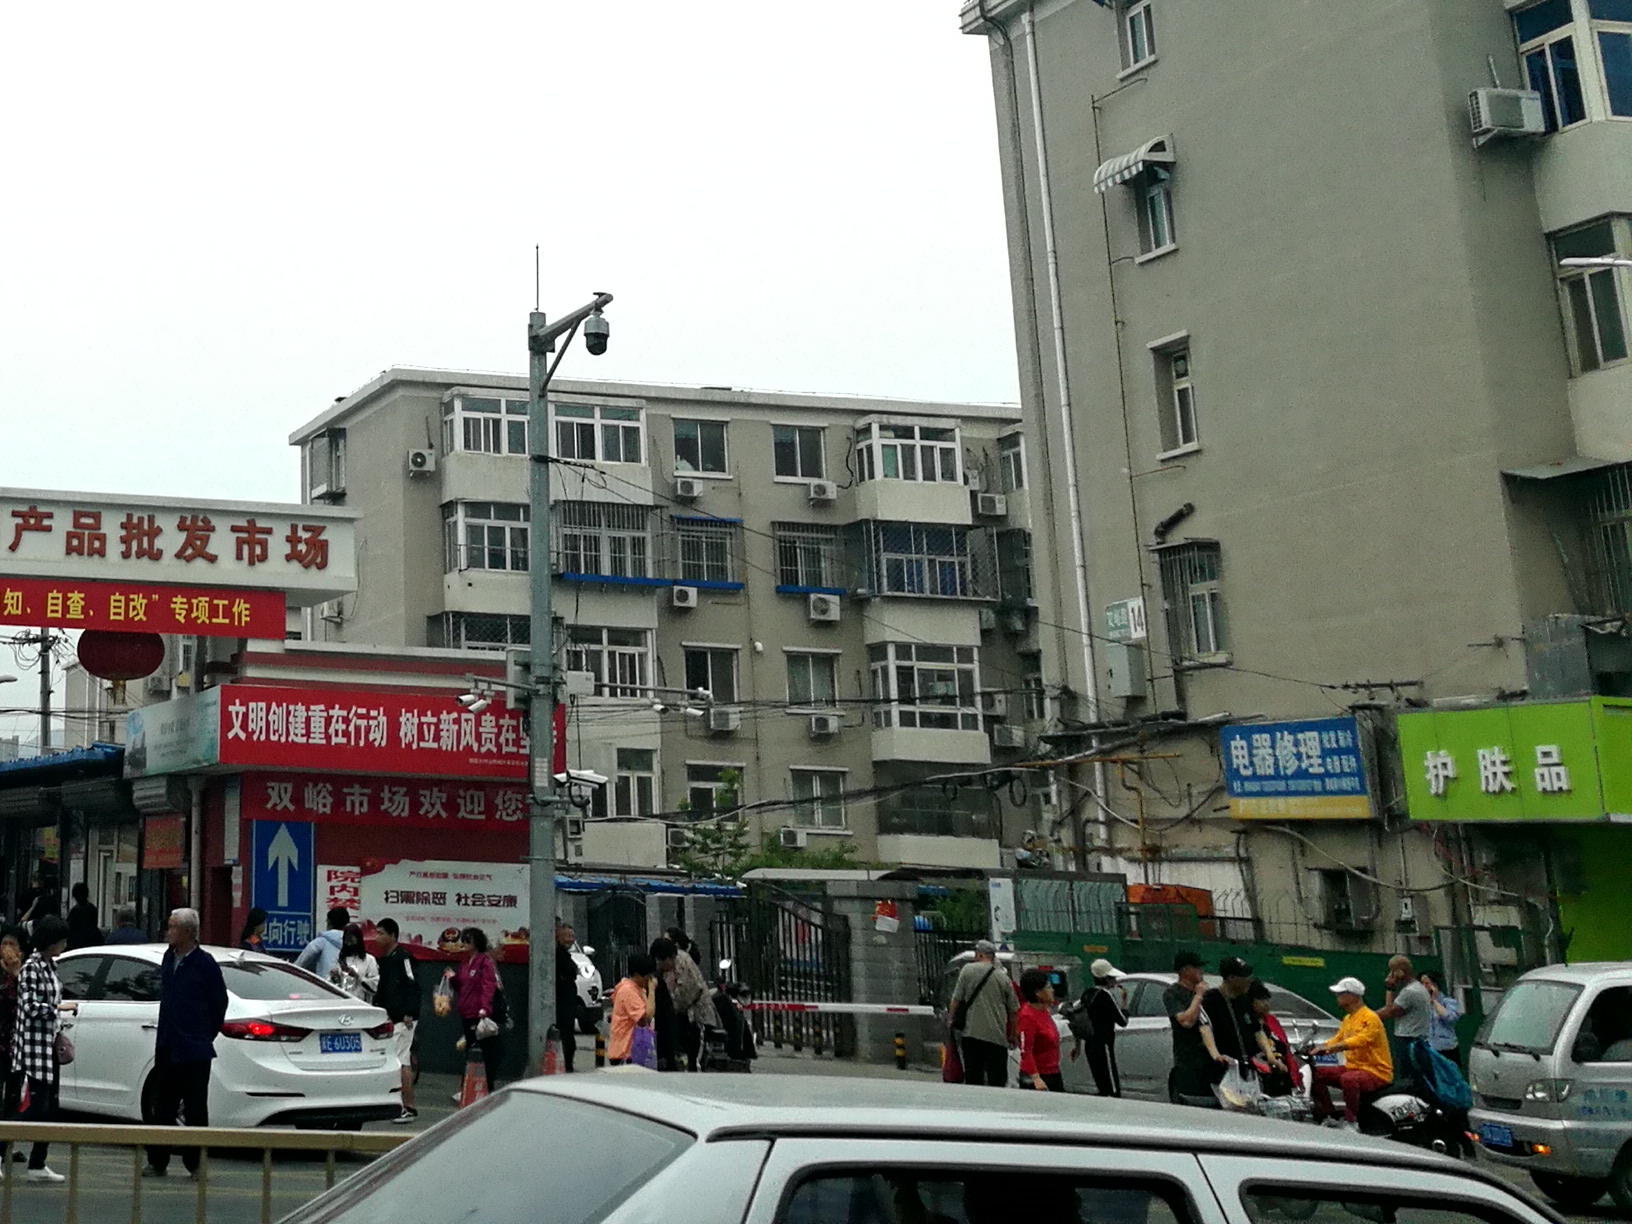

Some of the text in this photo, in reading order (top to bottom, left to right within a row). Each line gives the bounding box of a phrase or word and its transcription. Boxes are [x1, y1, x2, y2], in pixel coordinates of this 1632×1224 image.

[227, 698, 388, 748] 文明创建重在行动
[1230, 730, 1325, 777] 电器修理
[1425, 745, 1571, 796] 护肤品
[265, 782, 528, 822] 双峪市场欢迎您
[326, 868, 361, 922] 院内禁
[384, 890, 518, 908] 扫黑除恶 社会安康
